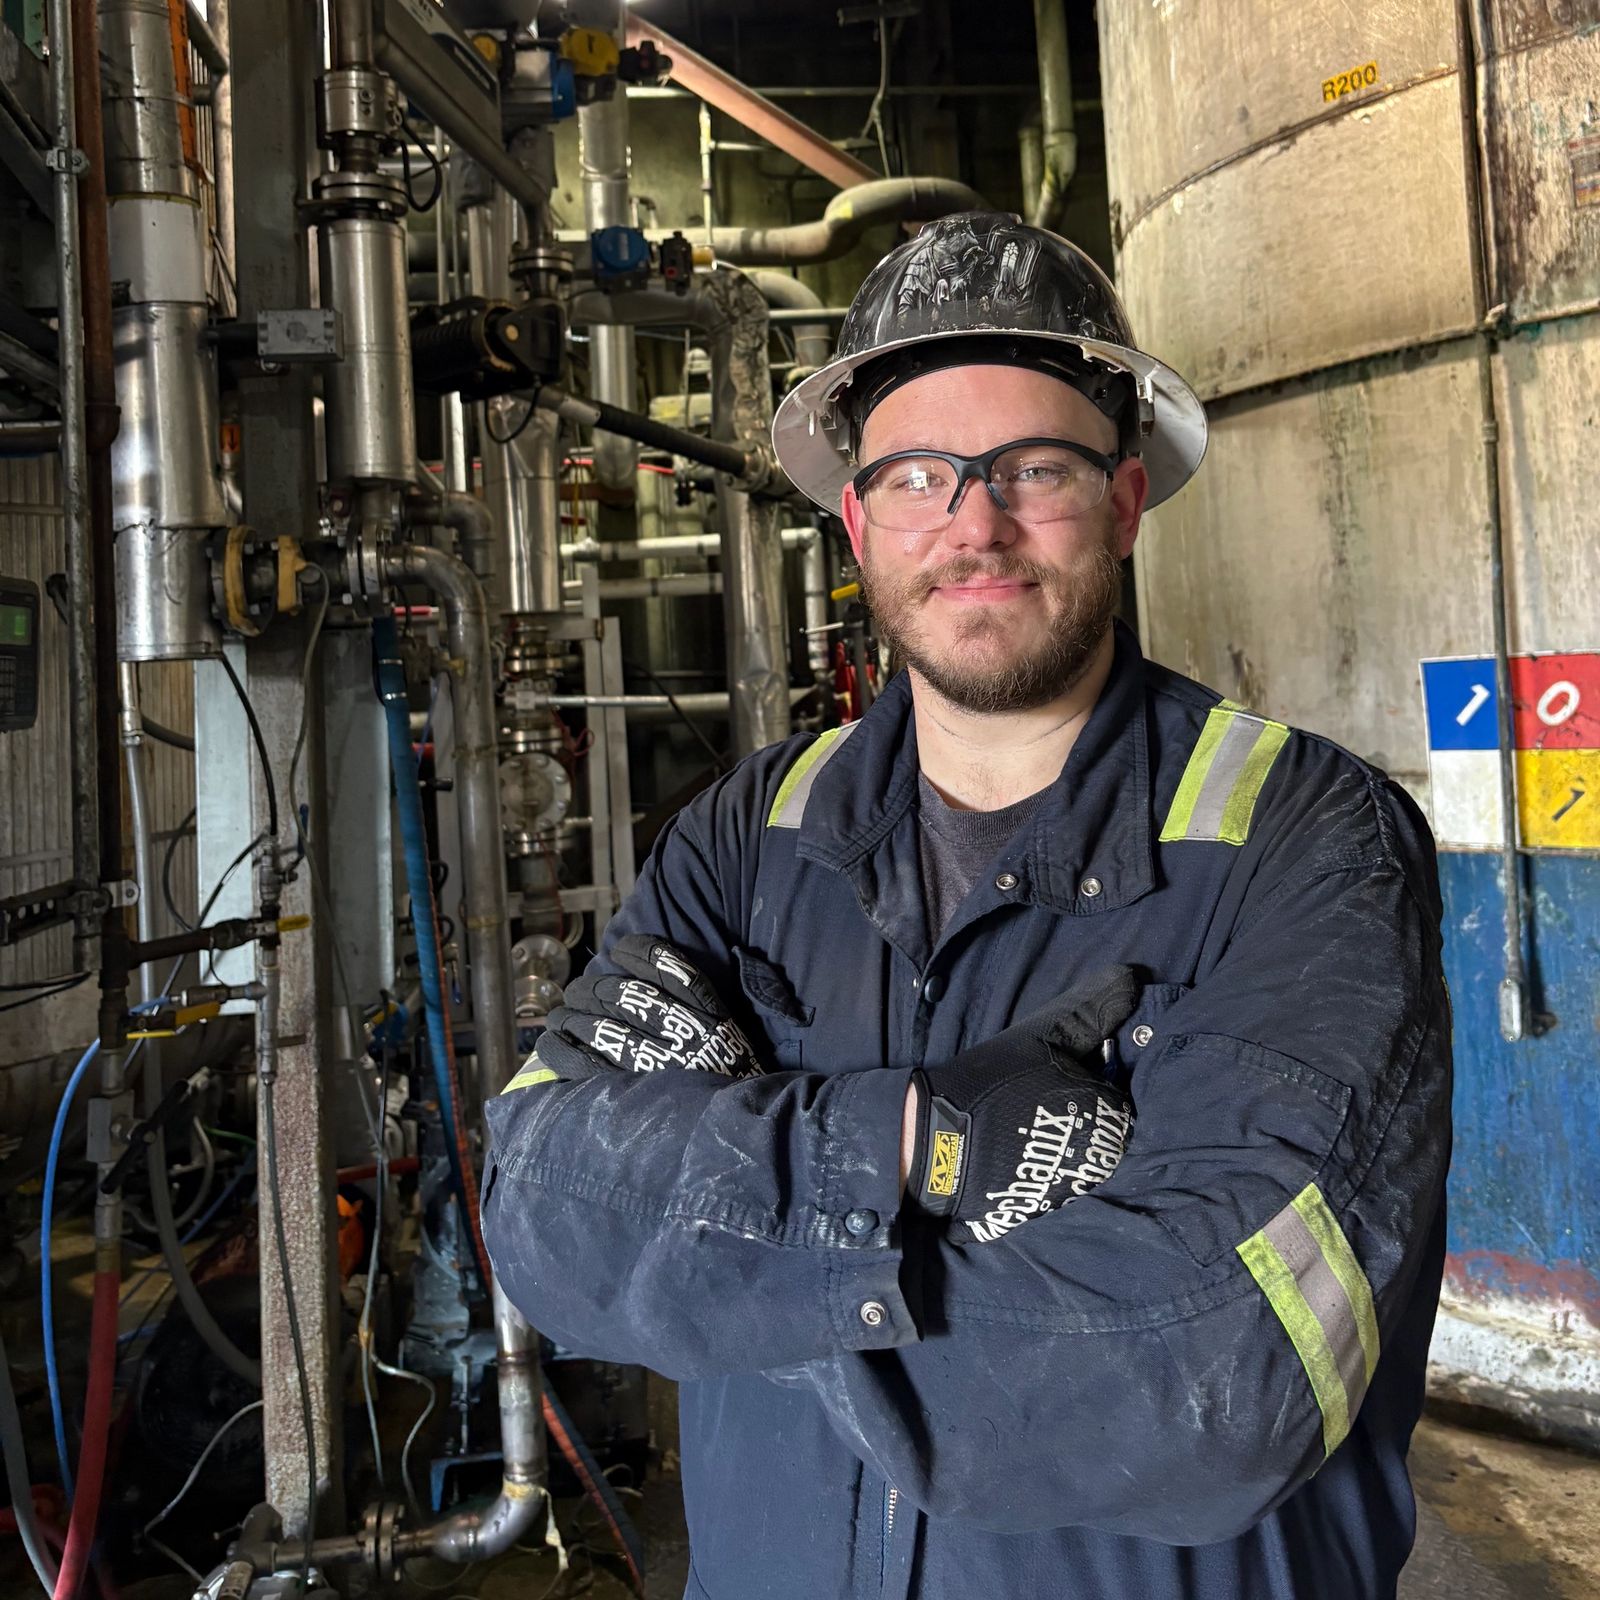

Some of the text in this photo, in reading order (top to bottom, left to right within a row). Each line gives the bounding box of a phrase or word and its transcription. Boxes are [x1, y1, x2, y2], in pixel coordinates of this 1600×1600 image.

[1322, 65, 1377, 103] R200
[1456, 684, 1490, 726] 1
[1552, 787, 1585, 822] 1
[951, 1177, 960, 1195] THE
